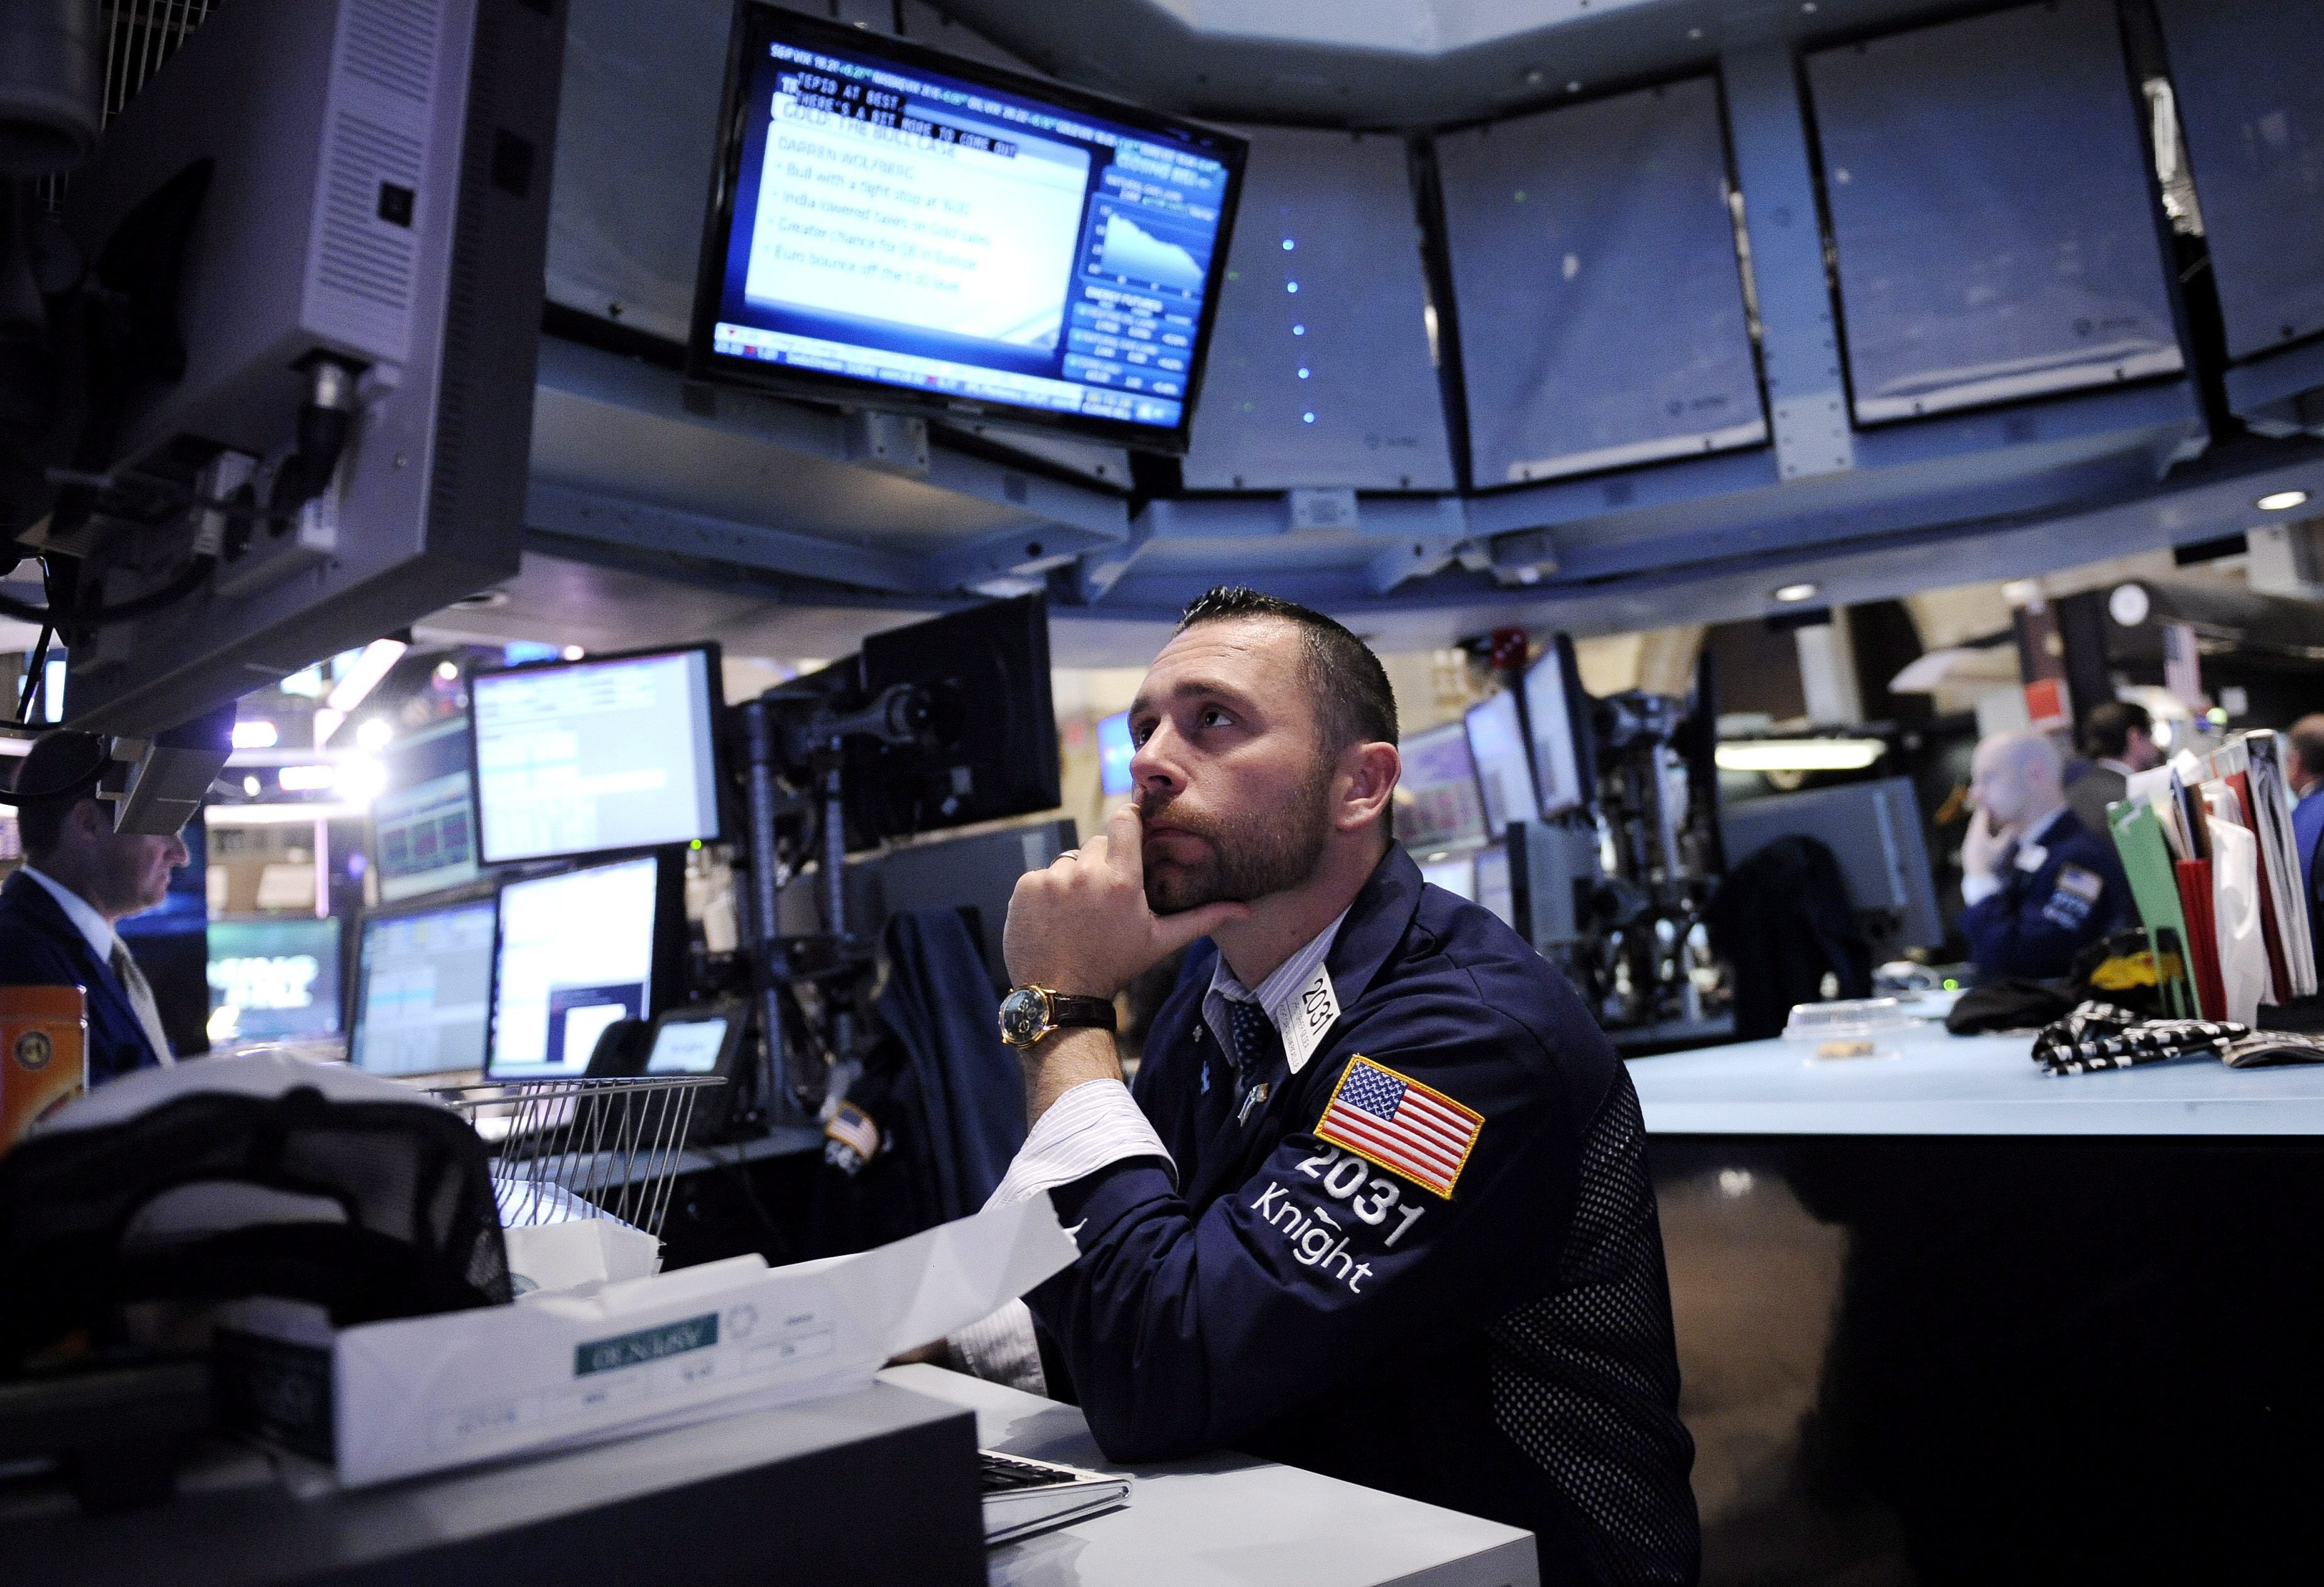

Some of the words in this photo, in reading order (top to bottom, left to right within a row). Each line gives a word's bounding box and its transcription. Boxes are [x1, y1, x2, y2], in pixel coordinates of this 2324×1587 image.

[798, 72, 838, 95] TEPID
[843, 84, 861, 101] AT
[796, 90, 851, 117] THERE'S
[856, 106, 866, 121] A
[871, 109, 897, 126] BIT
[901, 117, 933, 138] MORE
[939, 126, 956, 143] TO
[959, 133, 991, 151] COME
[993, 141, 1019, 158] OUT
[786, 162, 813, 181] Bull
[816, 172, 845, 187] with
[849, 179, 856, 190] a
[894, 188, 921, 206] stop
[925, 197, 938, 208] at
[782, 190, 817, 209] India
[820, 198, 870, 220] lowered
[913, 220, 926, 231] on
[930, 222, 958, 240] Gold
[774, 244, 806, 264] Euro
[808, 252, 856, 274] bounce
[860, 263, 878, 277] off
[881, 267, 902, 283] the
[778, 217, 828, 239] Greater
[830, 229, 875, 249] chance
[879, 239, 896, 252] for
[921, 248, 932, 260] in
[934, 250, 978, 271] Europe
[1302, 978, 1333, 1035] 2031
[1295, 1145, 1426, 1247] 2031
[1250, 1181, 1373, 1294] Knight
